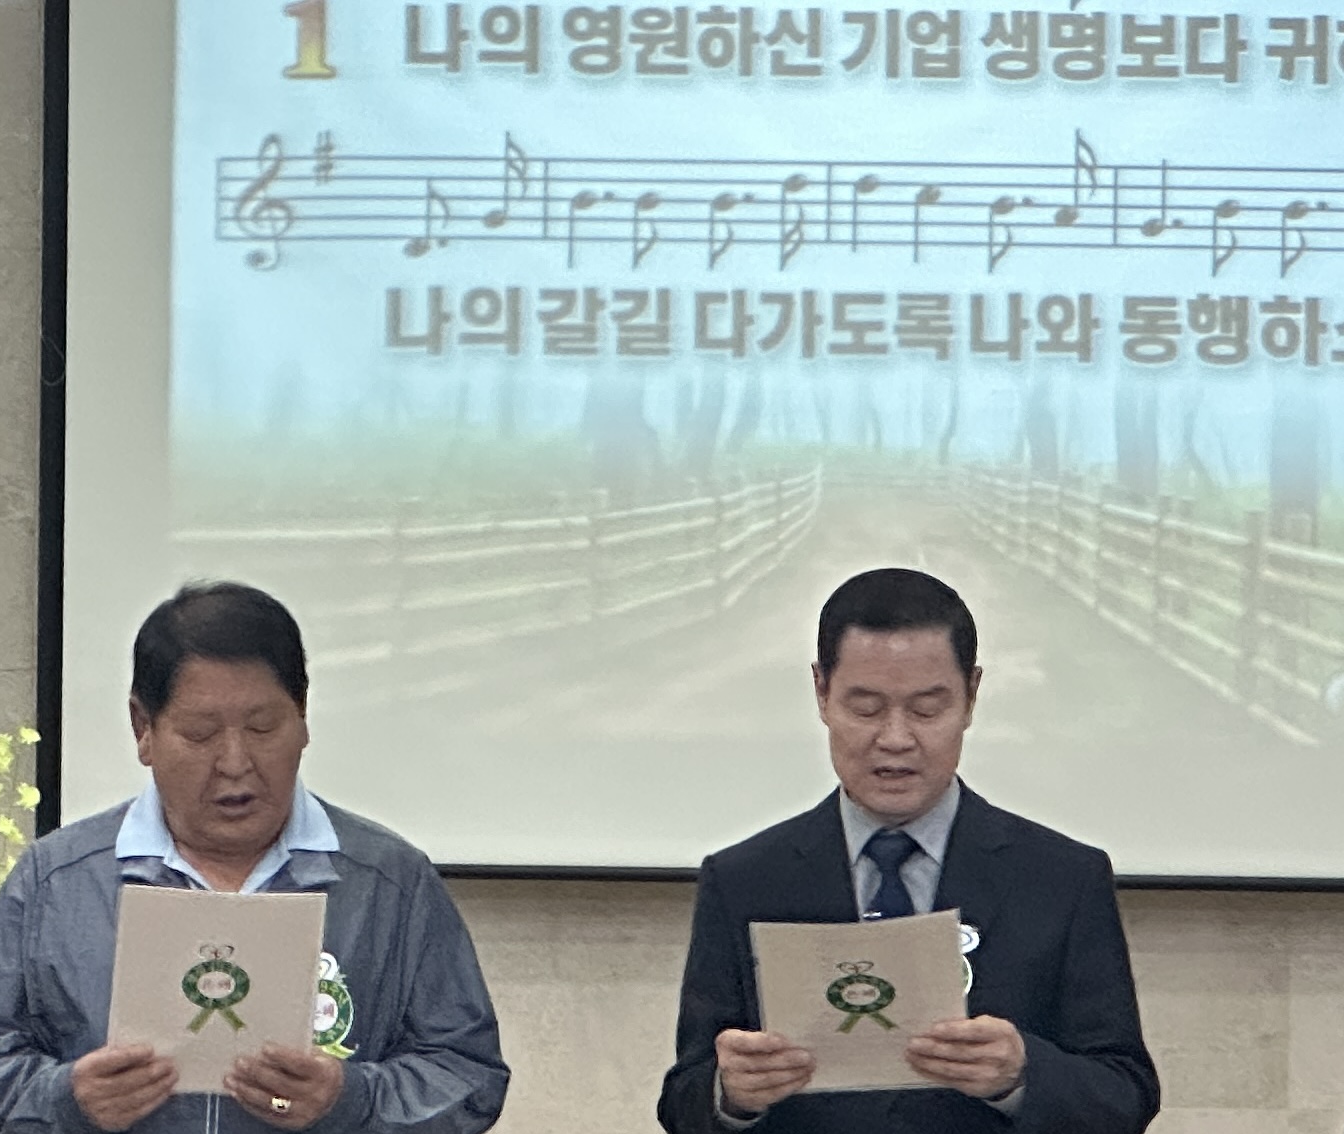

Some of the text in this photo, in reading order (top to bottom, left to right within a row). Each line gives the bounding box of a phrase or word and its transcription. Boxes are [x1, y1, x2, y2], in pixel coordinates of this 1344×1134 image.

[284, 0, 336, 78] 1
[404, 4, 540, 73] 나의
[562, 4, 822, 77] 영원하신
[841, 9, 960, 78] 기업
[981, 10, 1247, 82] 생명보다
[385, 286, 521, 355] 나의
[537, 287, 670, 355] 갈길
[694, 290, 953, 360] 다가도록
[970, 292, 1099, 362] 나와
